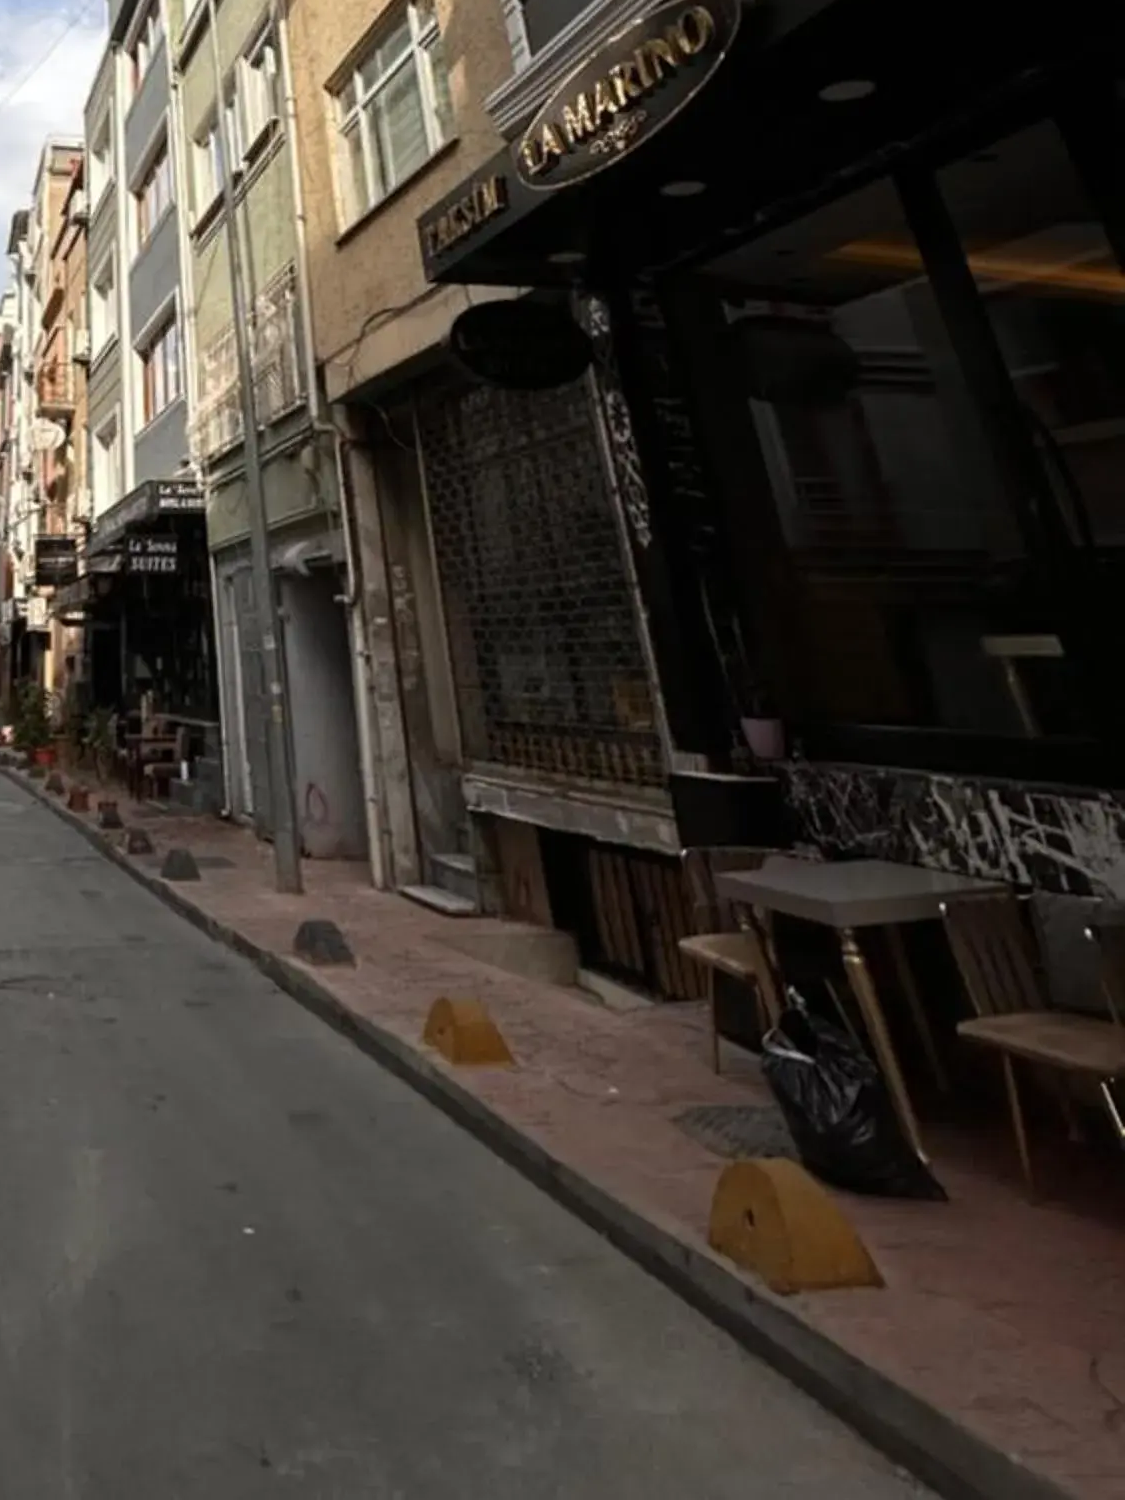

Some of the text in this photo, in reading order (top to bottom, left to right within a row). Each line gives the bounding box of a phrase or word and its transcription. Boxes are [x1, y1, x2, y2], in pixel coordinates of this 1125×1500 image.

[520, 5, 715, 176] LA MARINO
[131, 556, 177, 572] SUITES
